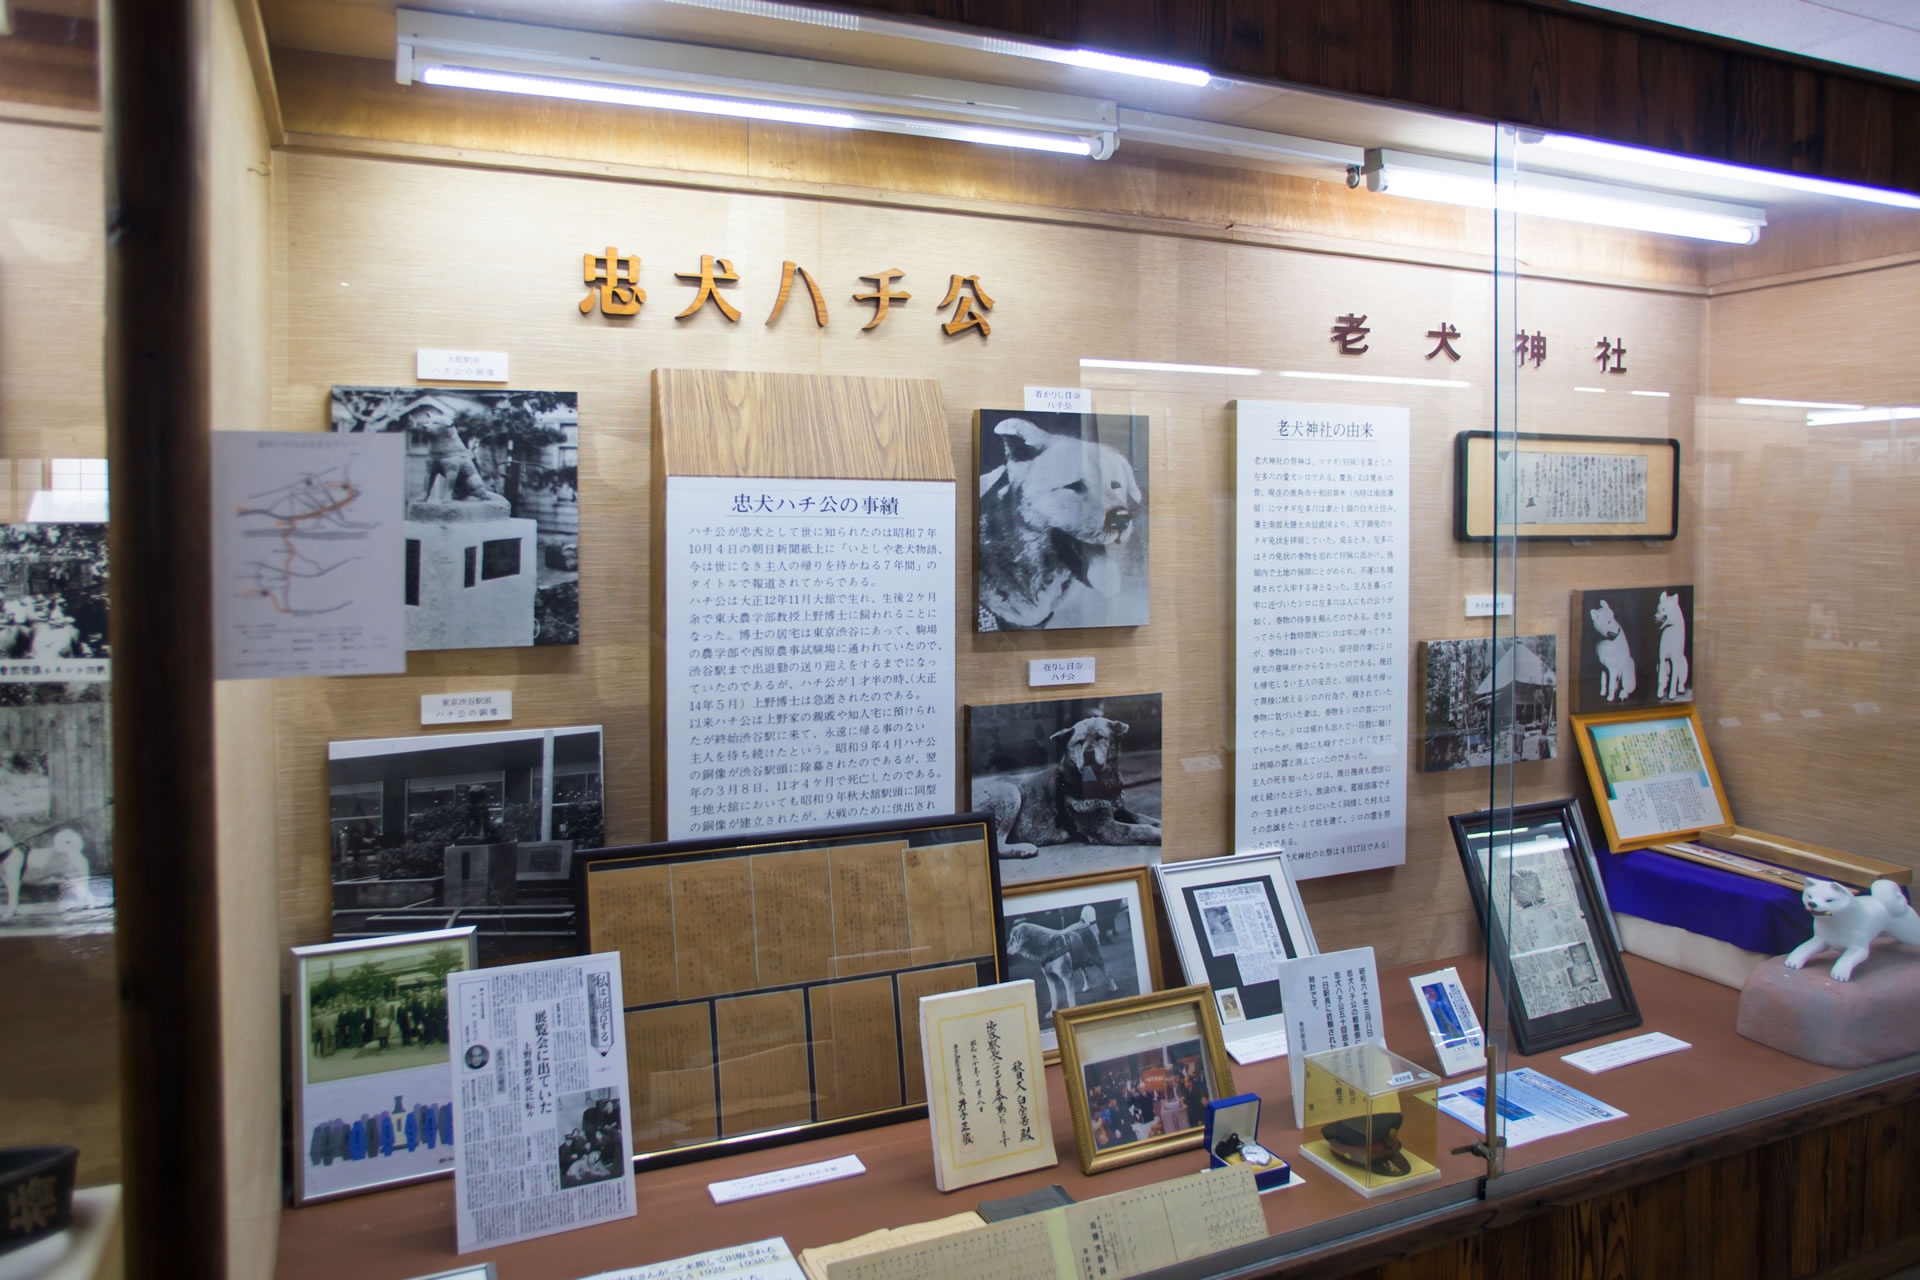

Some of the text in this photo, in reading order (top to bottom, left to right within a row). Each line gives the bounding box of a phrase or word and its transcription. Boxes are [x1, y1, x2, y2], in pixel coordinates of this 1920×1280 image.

[579, 246, 995, 337] 忠犬ハチ公
[1331, 313, 1627, 373] 老犬神社
[1047, 401, 1073, 410] ハチ公
[1276, 419, 1374, 438] 老犬神社の由来
[732, 493, 899, 516] 忠犬ハチ公の事績
[690, 576, 876, 589] タイトルで報道されてからである。
[1043, 662, 1083, 671] 在りし日の
[1052, 673, 1076, 681] ハチ公
[1359, 967, 1373, 1037] 昭和六十年三月八日
[535, 1010, 552, 1114] 展覧会に出ていた
